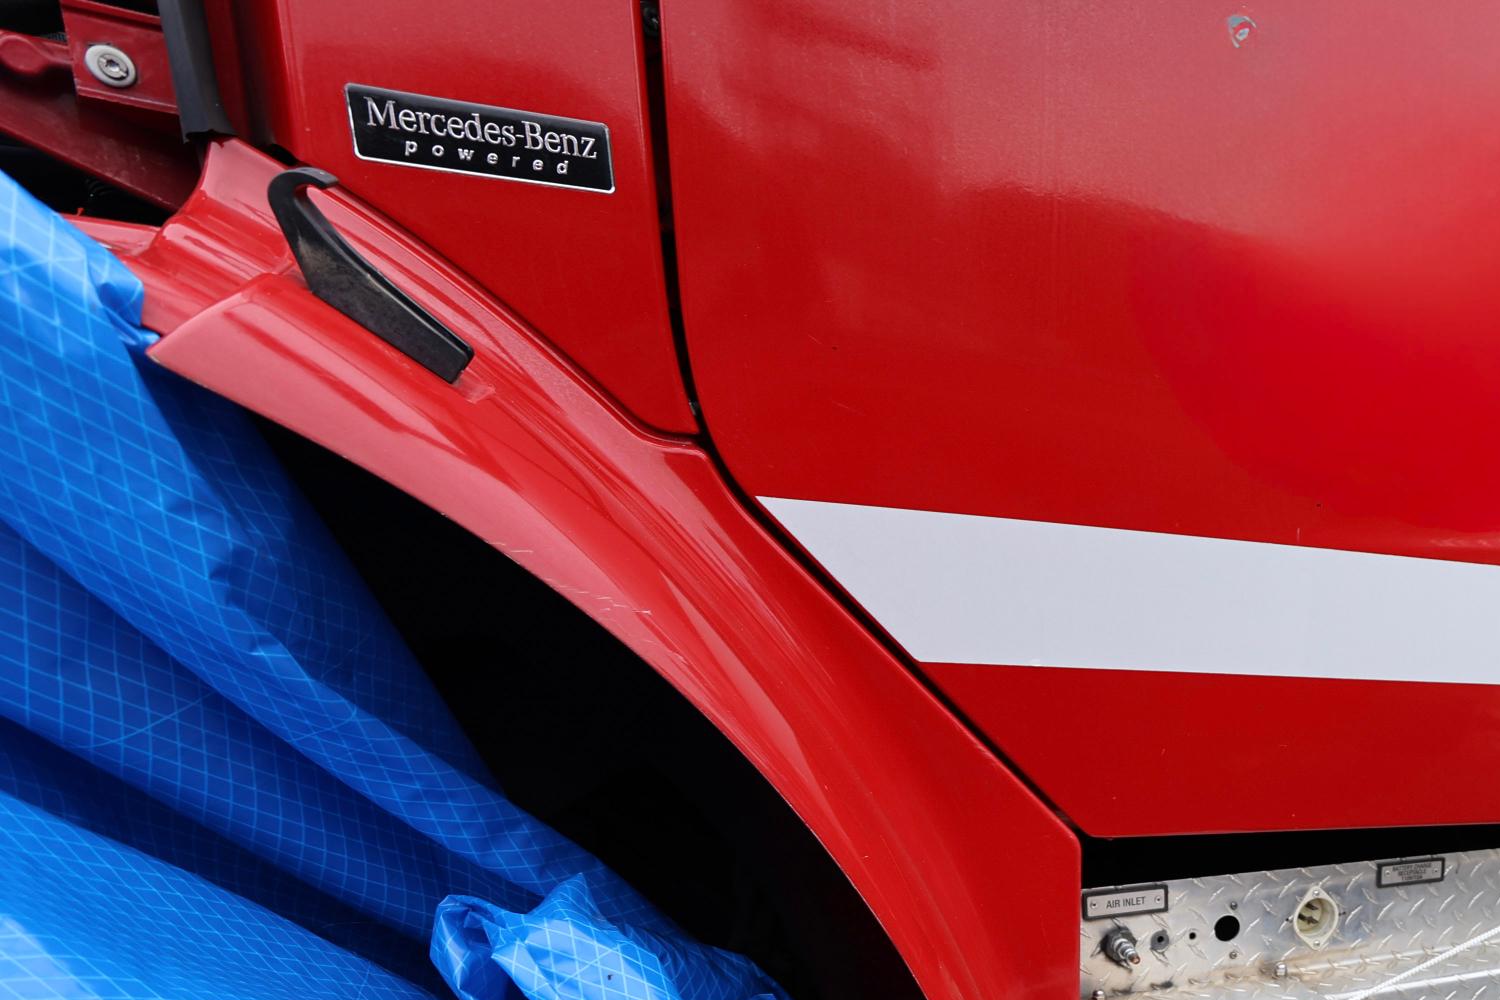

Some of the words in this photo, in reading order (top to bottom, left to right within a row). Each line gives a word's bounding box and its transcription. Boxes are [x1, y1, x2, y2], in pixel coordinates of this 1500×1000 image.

[363, 96, 598, 159] Mercedes-Benz
[404, 138, 569, 175] powered
[1106, 899, 1121, 909] AIR
[1122, 896, 1146, 907] INLET
